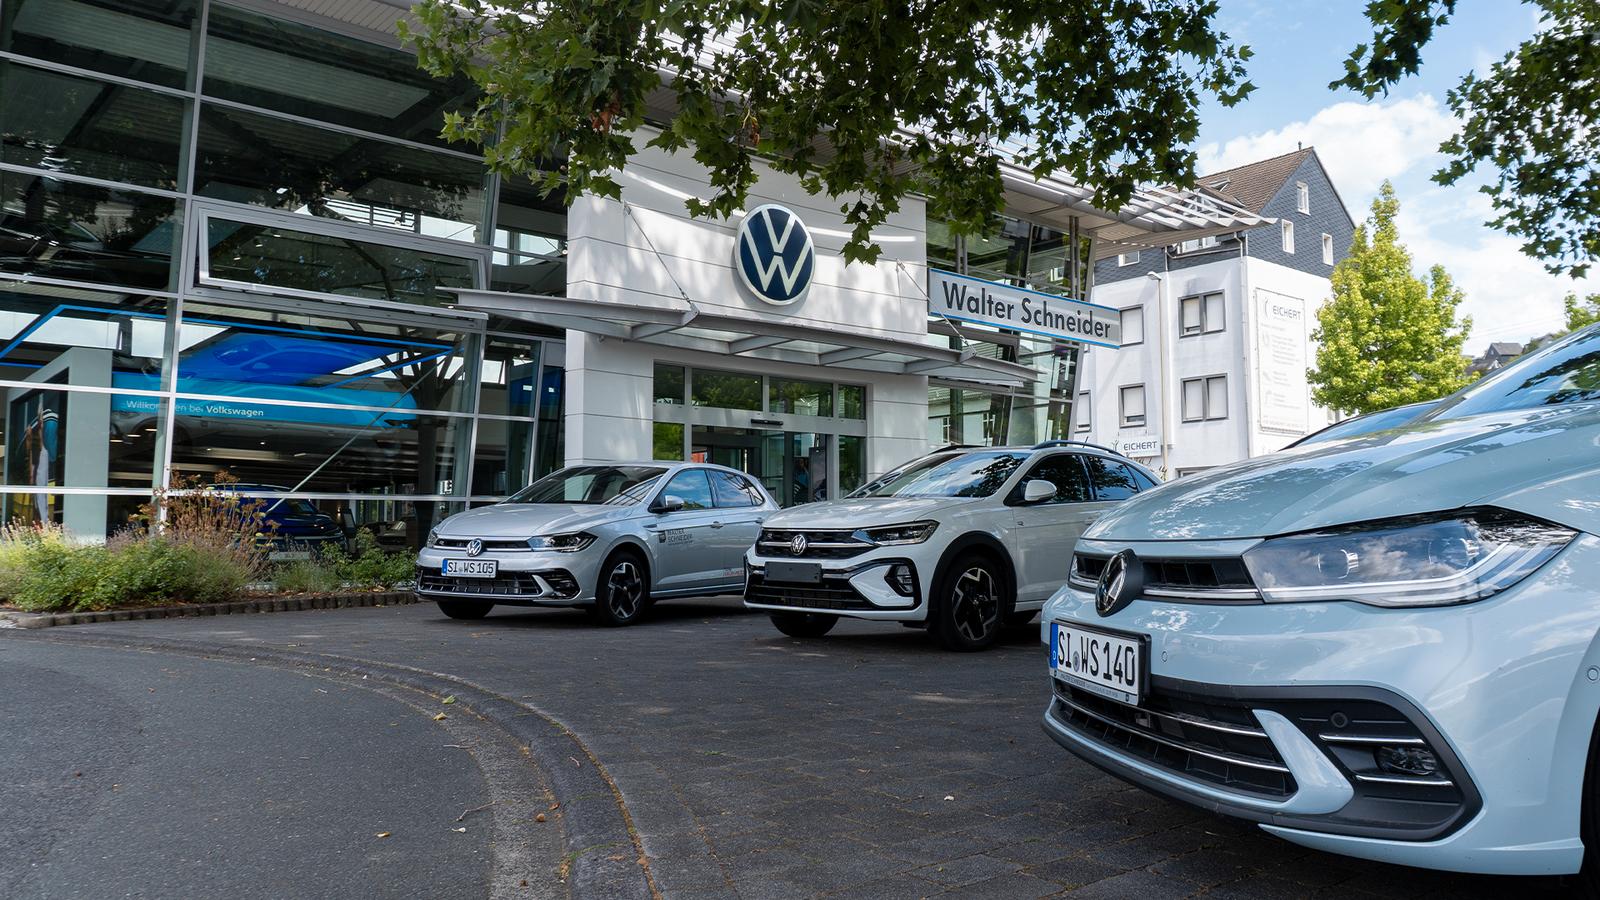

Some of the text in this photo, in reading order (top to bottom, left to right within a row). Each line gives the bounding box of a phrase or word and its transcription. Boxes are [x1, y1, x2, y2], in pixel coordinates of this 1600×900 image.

[942, 280, 1111, 338] Walter Schneider
[1273, 305, 1301, 320] EICHERT
[127, 399, 187, 412] Willkoen
[206, 405, 264, 418] Volkswagen
[1123, 441, 1158, 451] EICHERT
[447, 561, 458, 573] SI
[476, 562, 494, 574] 105
[1058, 631, 1135, 686] SI WS 140
